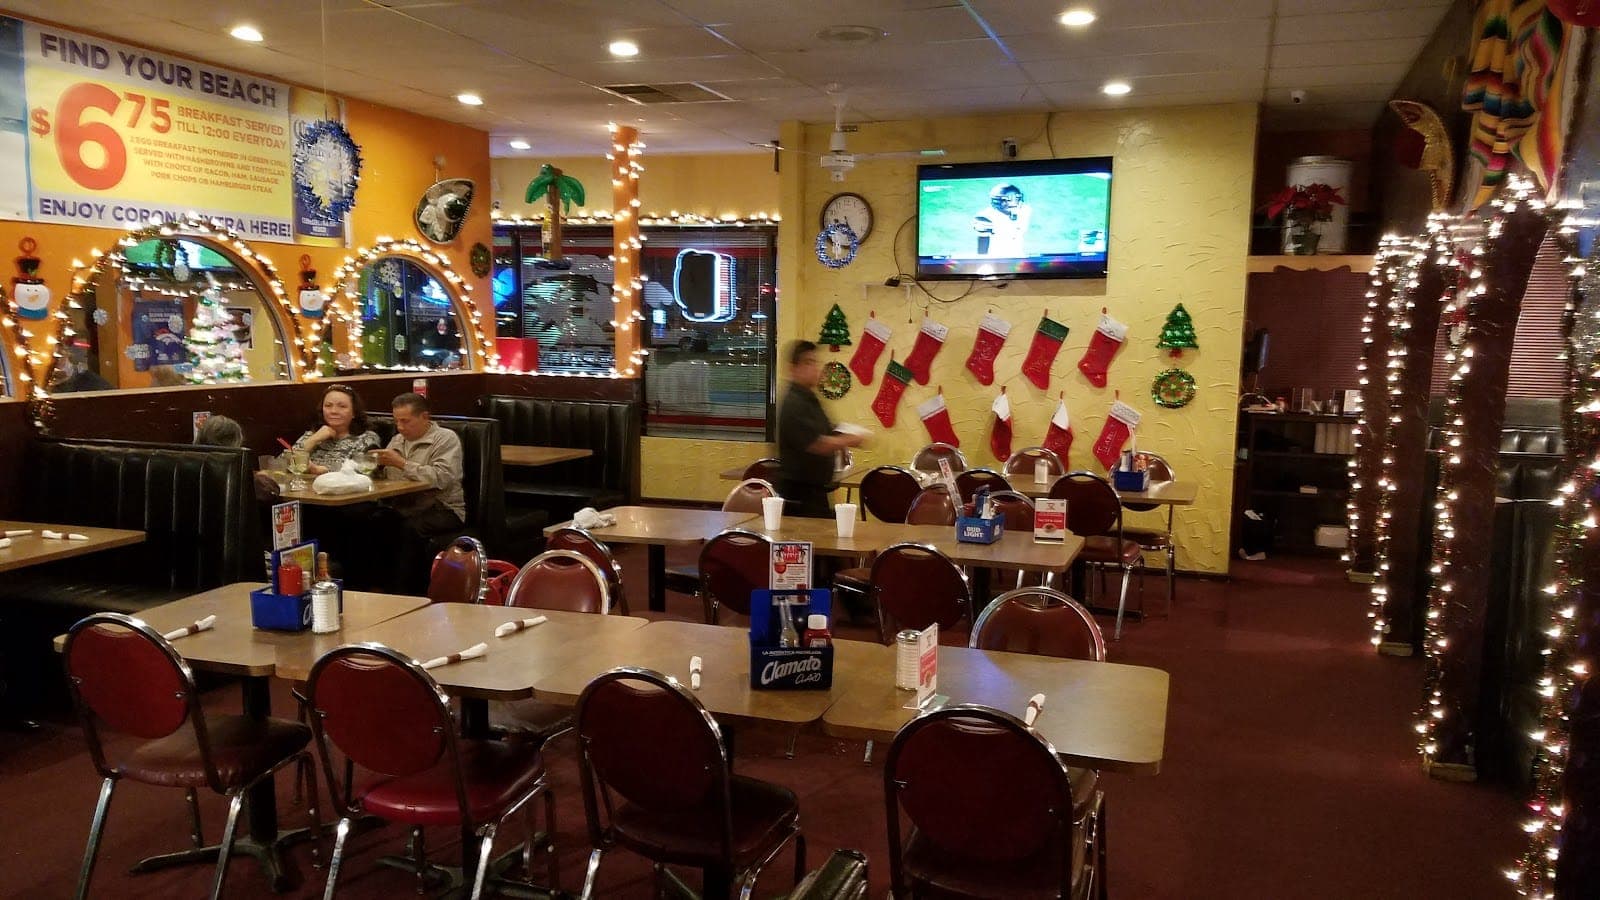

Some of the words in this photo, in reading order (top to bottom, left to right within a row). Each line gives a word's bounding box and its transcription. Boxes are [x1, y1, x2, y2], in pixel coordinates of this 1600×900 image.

[40, 33, 109, 70] FIND
[118, 51, 192, 89] YOUR
[200, 71, 277, 107] BEACH
[176, 121, 198, 134] TILL
[202, 125, 230, 139] 12:00
[233, 131, 287, 150] EVERYDAY
[177, 106, 242, 128] BREAKFAST
[244, 118, 284, 136] SERVED
[39, 198, 106, 221] ENJOY
[250, 219, 291, 238] HERE!
[761, 655, 821, 685] Clamato
